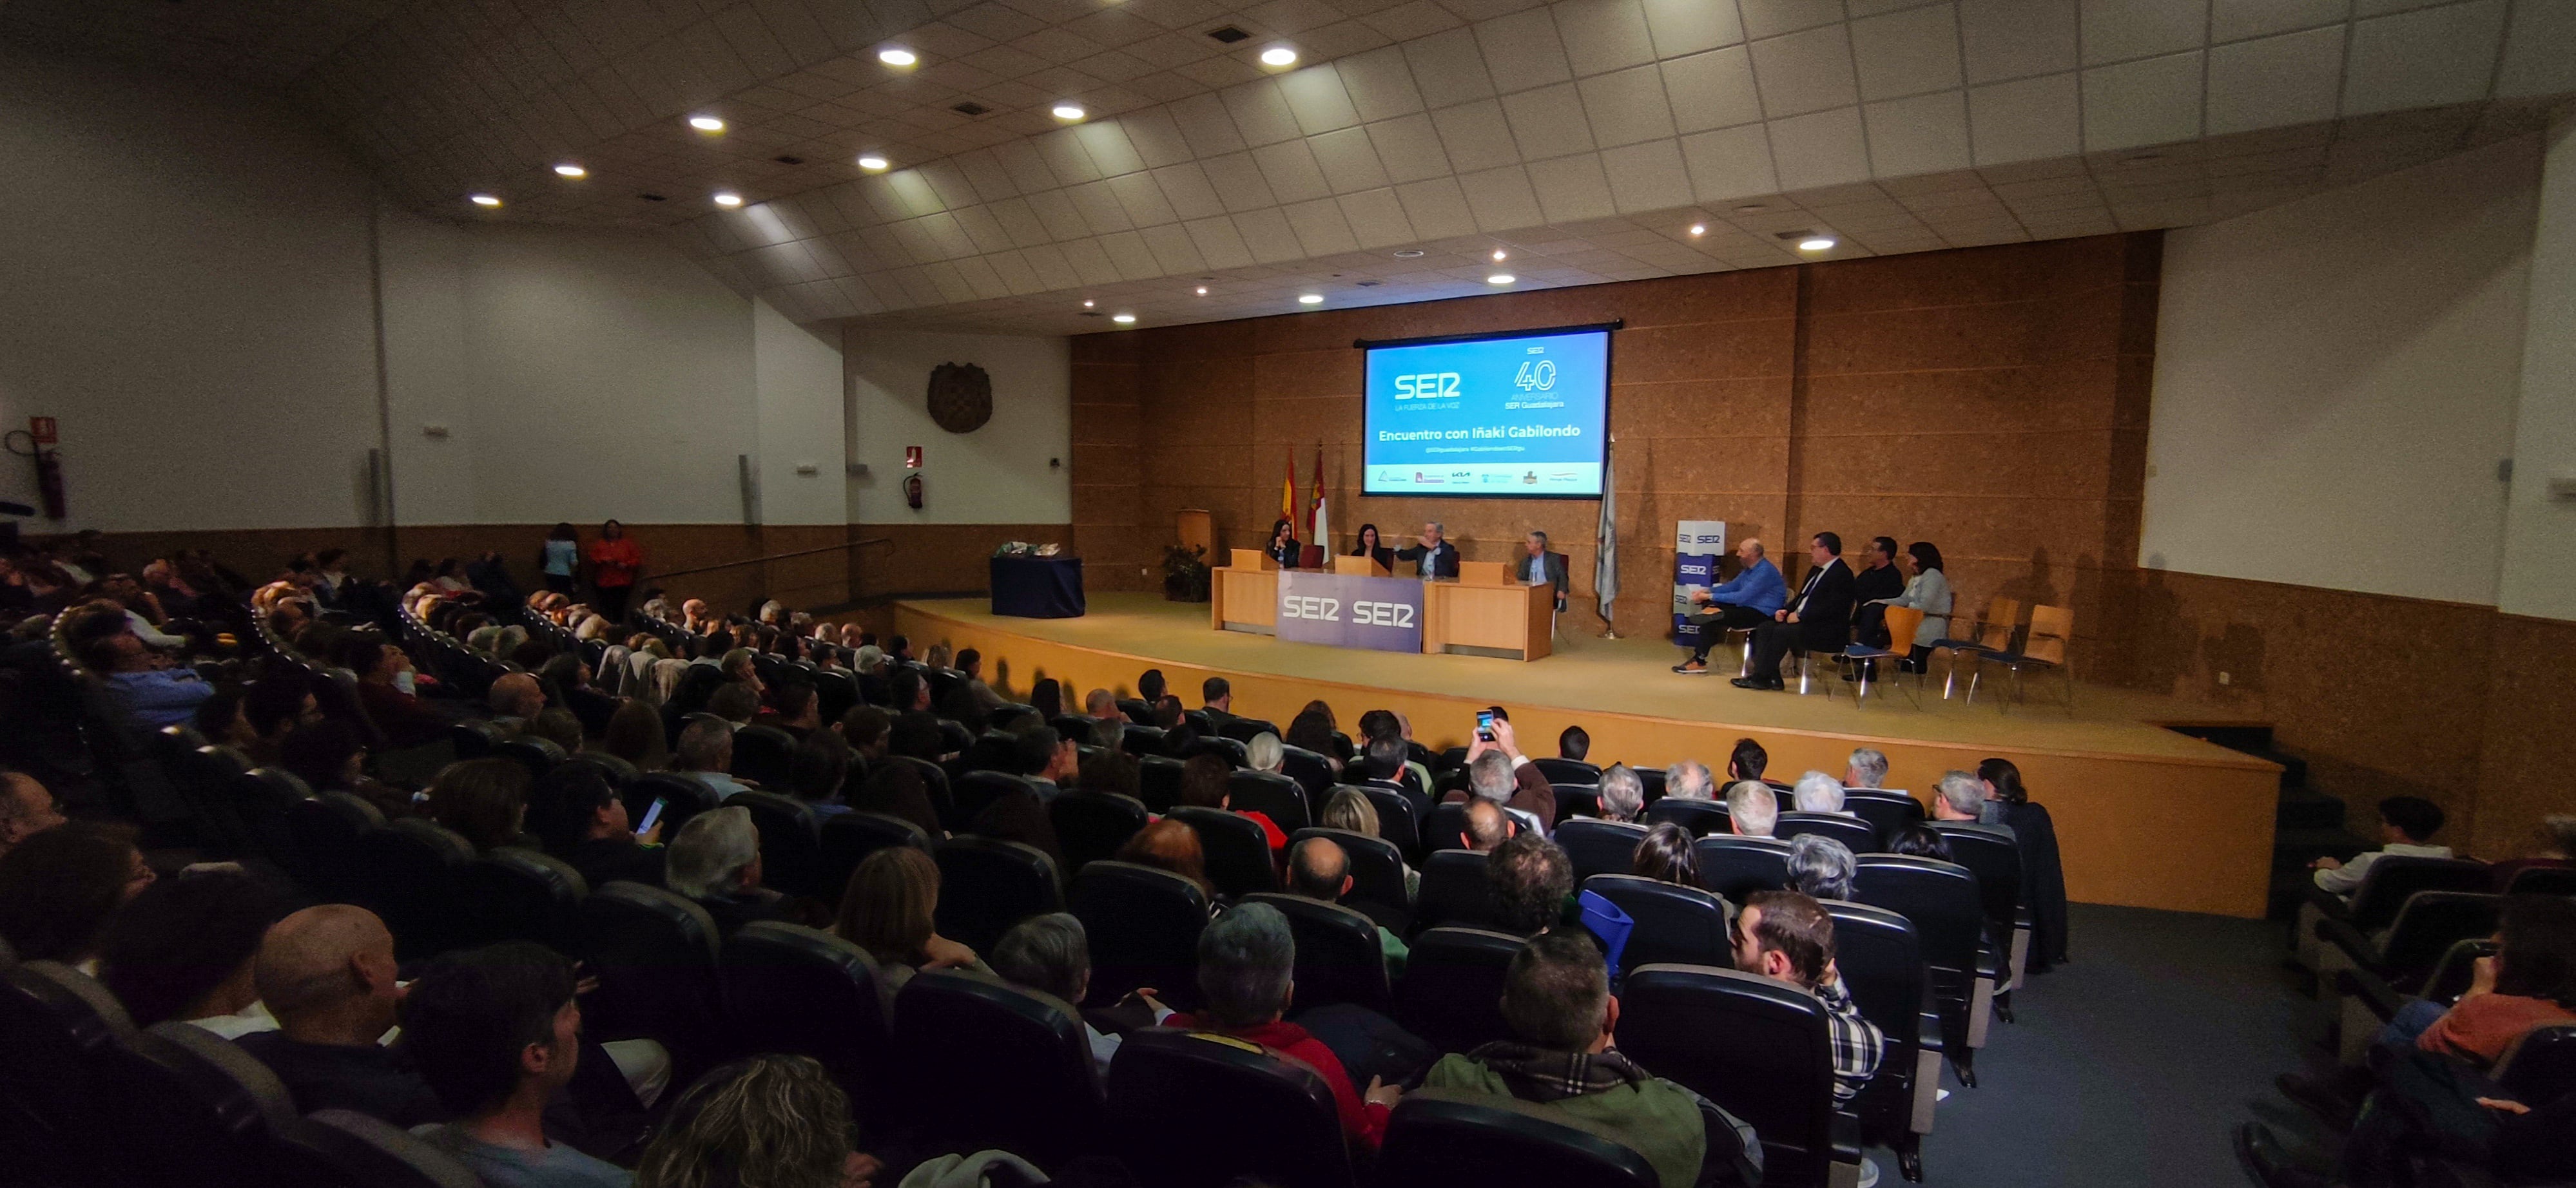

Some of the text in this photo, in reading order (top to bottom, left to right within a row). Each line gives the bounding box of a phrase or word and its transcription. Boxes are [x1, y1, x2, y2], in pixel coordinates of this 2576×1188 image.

[1514, 359, 1556, 392] 40
[1395, 372, 1460, 400] SER
[1522, 401, 1564, 409] Guadalajara
[1379, 424, 1581, 441] Encuentro con Iñaki Gabilondo
[1679, 533, 1691, 543] SER
[1697, 535, 1720, 544] SER
[1680, 564, 1707, 575] SER
[1675, 595, 1688, 604] SER
[1283, 595, 1415, 629] SER SER
